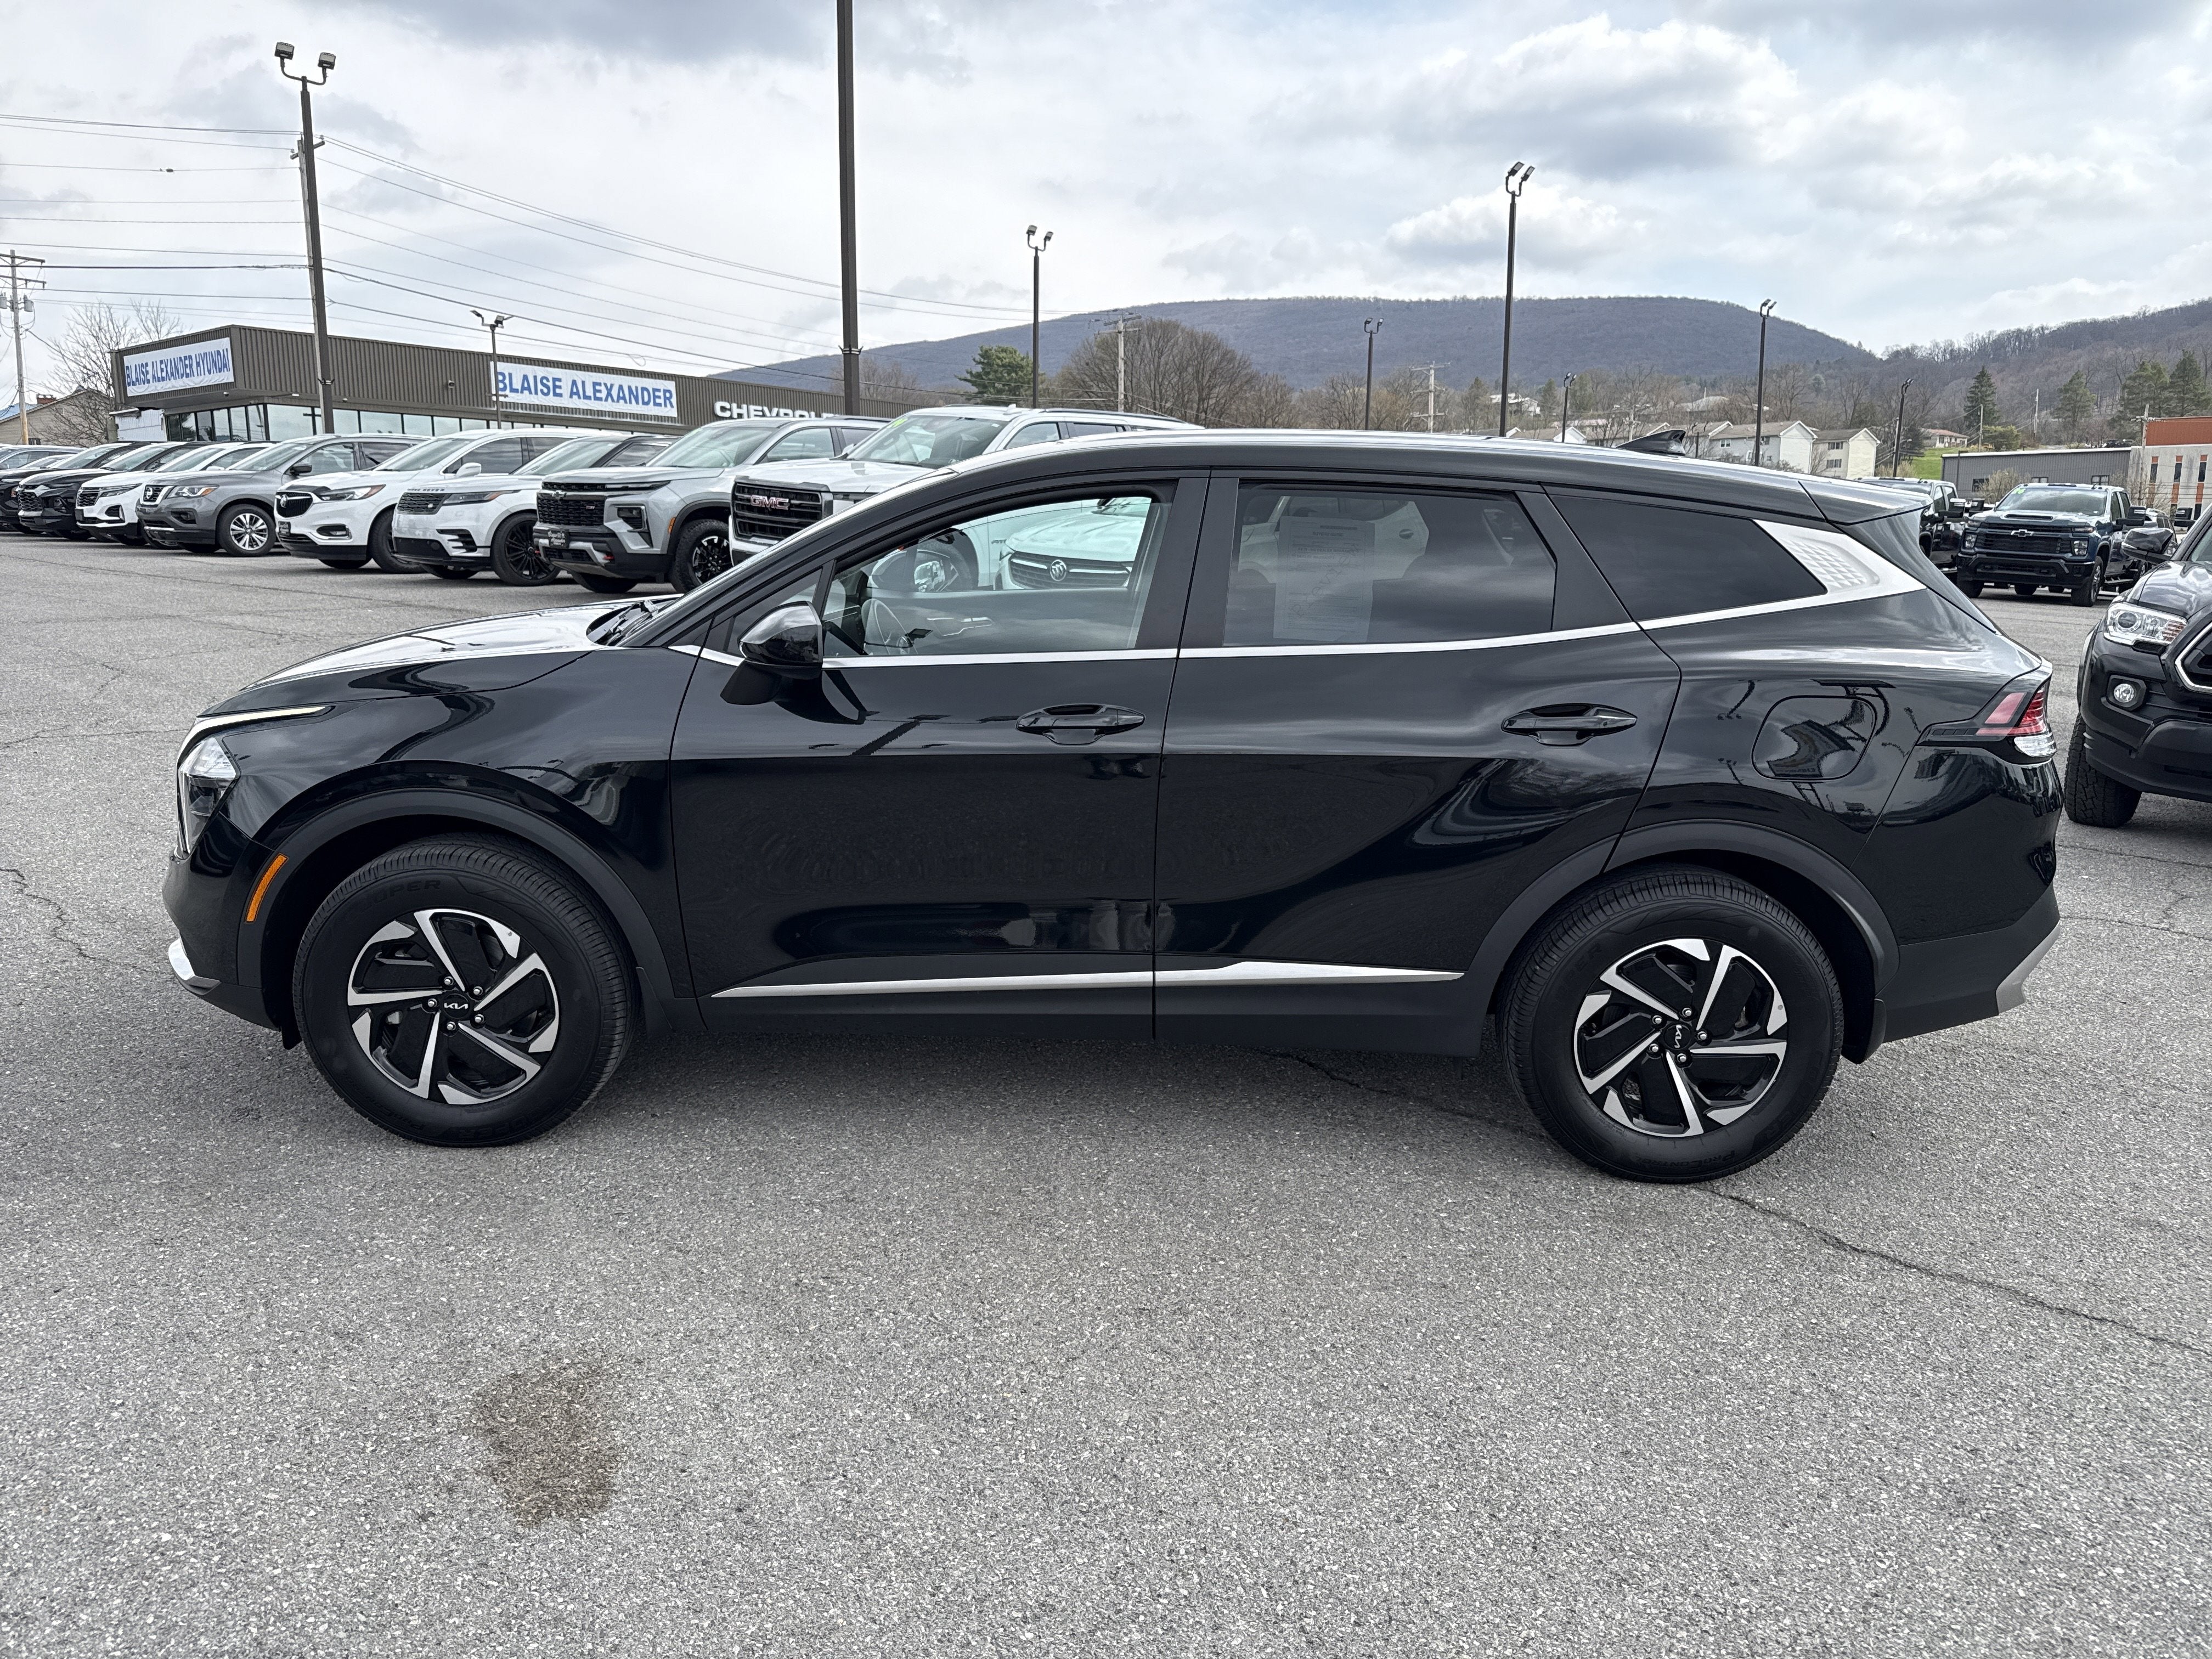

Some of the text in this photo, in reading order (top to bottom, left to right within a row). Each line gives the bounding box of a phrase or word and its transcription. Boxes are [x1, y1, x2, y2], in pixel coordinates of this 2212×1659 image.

[126, 348, 230, 387] BLAISE ALEXANDER HYUNDAI
[497, 371, 674, 409] BLAISE ALEXANDER
[714, 401, 840, 419] CHEVRO
[750, 495, 789, 510] GMC
